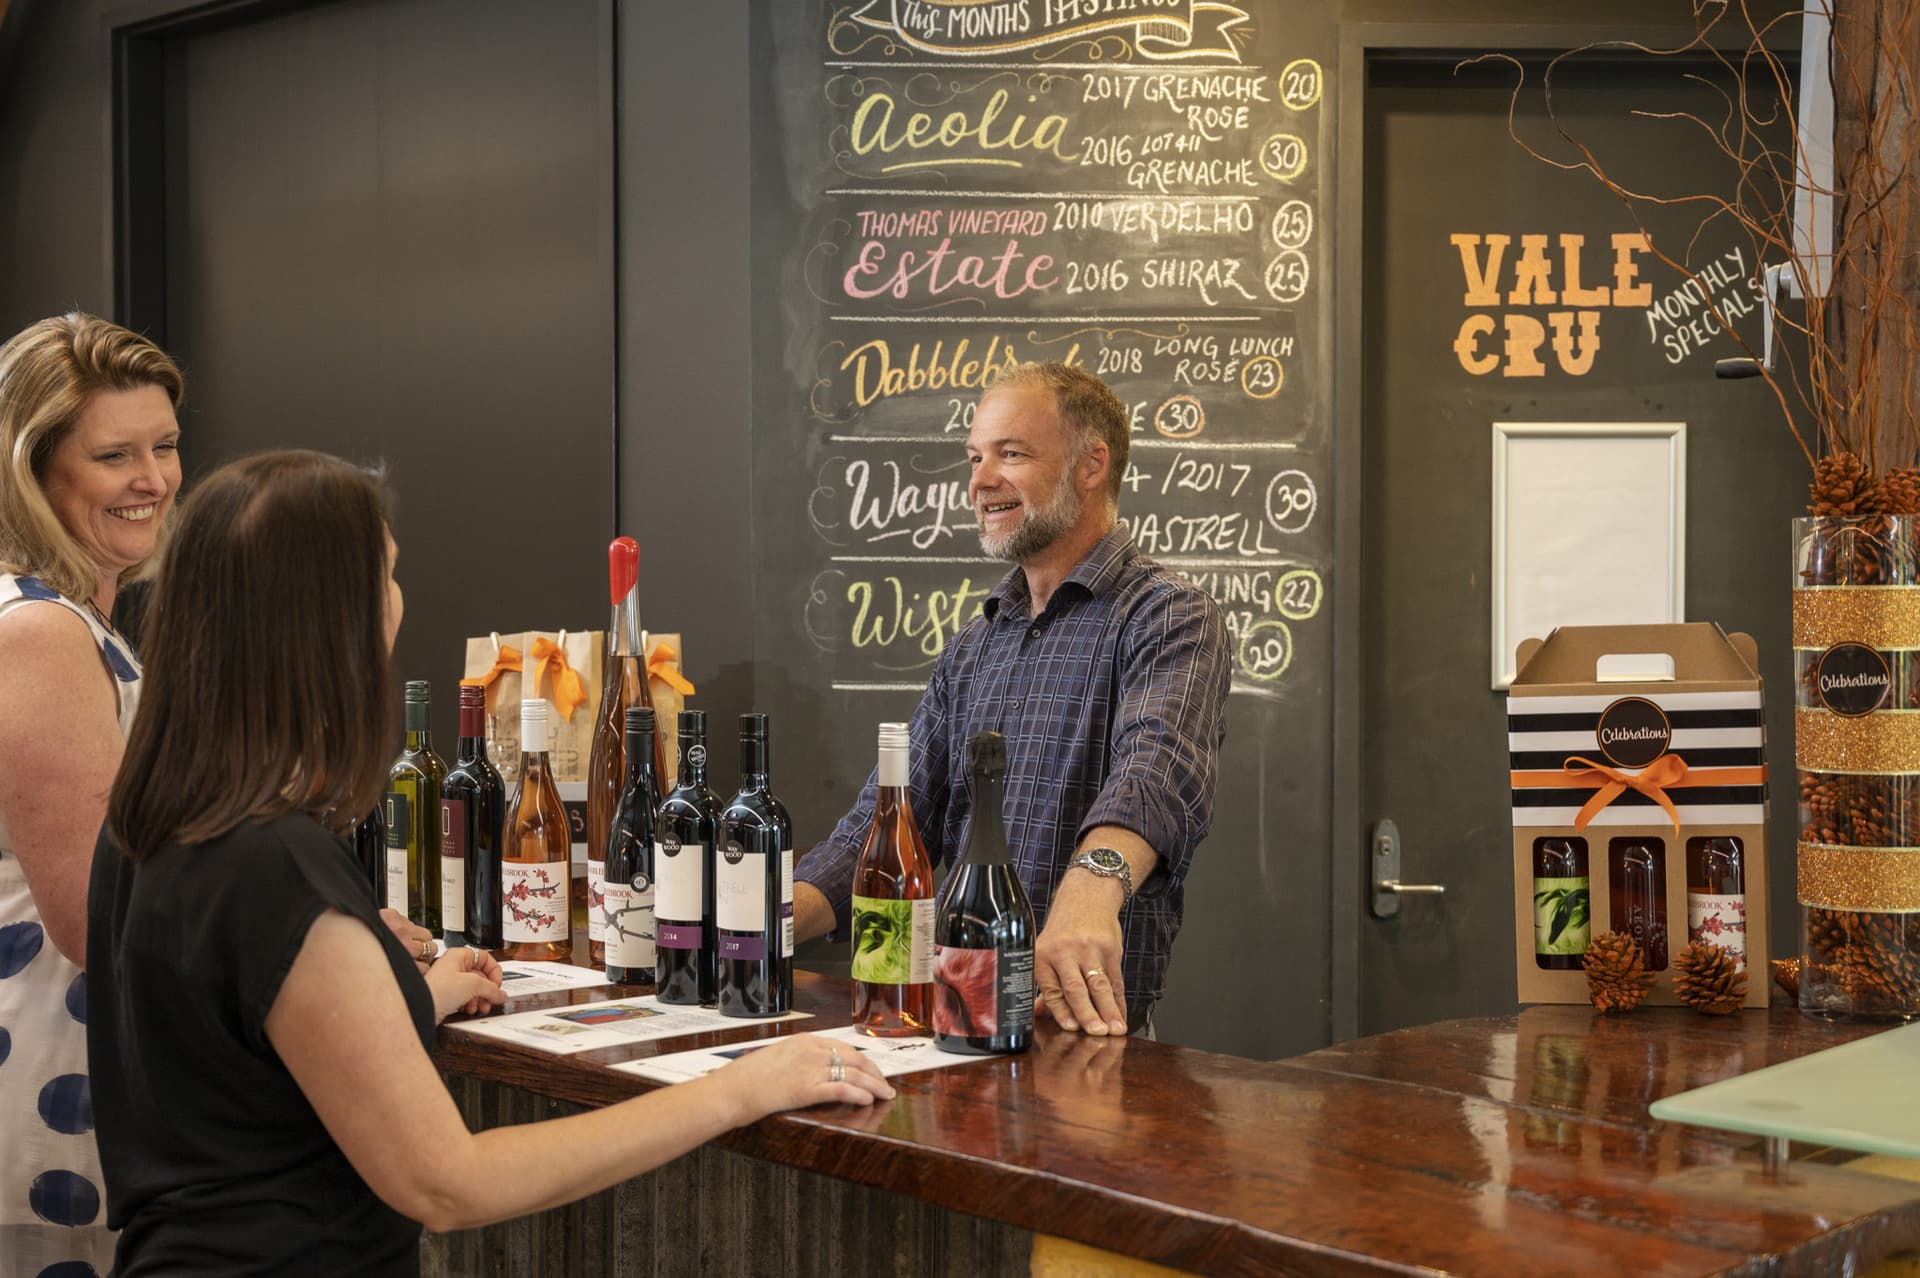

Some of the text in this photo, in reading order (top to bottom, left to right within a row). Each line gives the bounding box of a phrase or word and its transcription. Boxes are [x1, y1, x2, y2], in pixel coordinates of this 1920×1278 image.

[903, 2, 942, 39] This
[948, 0, 1031, 39] MONTHS
[1082, 73, 1271, 113] 2017 GRENACHE
[1286, 71, 1316, 101] 20
[1080, 134, 1132, 167] 2016
[1141, 132, 1174, 156] LOT
[1266, 141, 1299, 170] 30
[1127, 157, 1259, 194] GRENACHE
[856, 209, 1048, 238] THOMAS VINEYARD
[1111, 202, 1253, 244] VERDELHO
[1277, 209, 1306, 239] 25
[843, 237, 1060, 299] Estate
[1066, 257, 1257, 306] 2016 SHIRAZ
[1270, 261, 1305, 293] 25
[1450, 233, 1653, 306] VALE
[1646, 246, 1745, 344] MONTHLY
[1664, 277, 1764, 364] SPECIALS
[1096, 336, 1293, 375] 2018 LONG LUNCH
[1453, 311, 1600, 377] CRU
[1248, 361, 1275, 390] 23
[944, 398, 977, 433] 20
[1160, 403, 1199, 433] 30
[1275, 484, 1312, 521] 30
[1283, 578, 1313, 609] 22
[1249, 638, 1284, 672] 20
[1821, 671, 1889, 693] Celebrations
[1601, 725, 1669, 744] Celebrations
